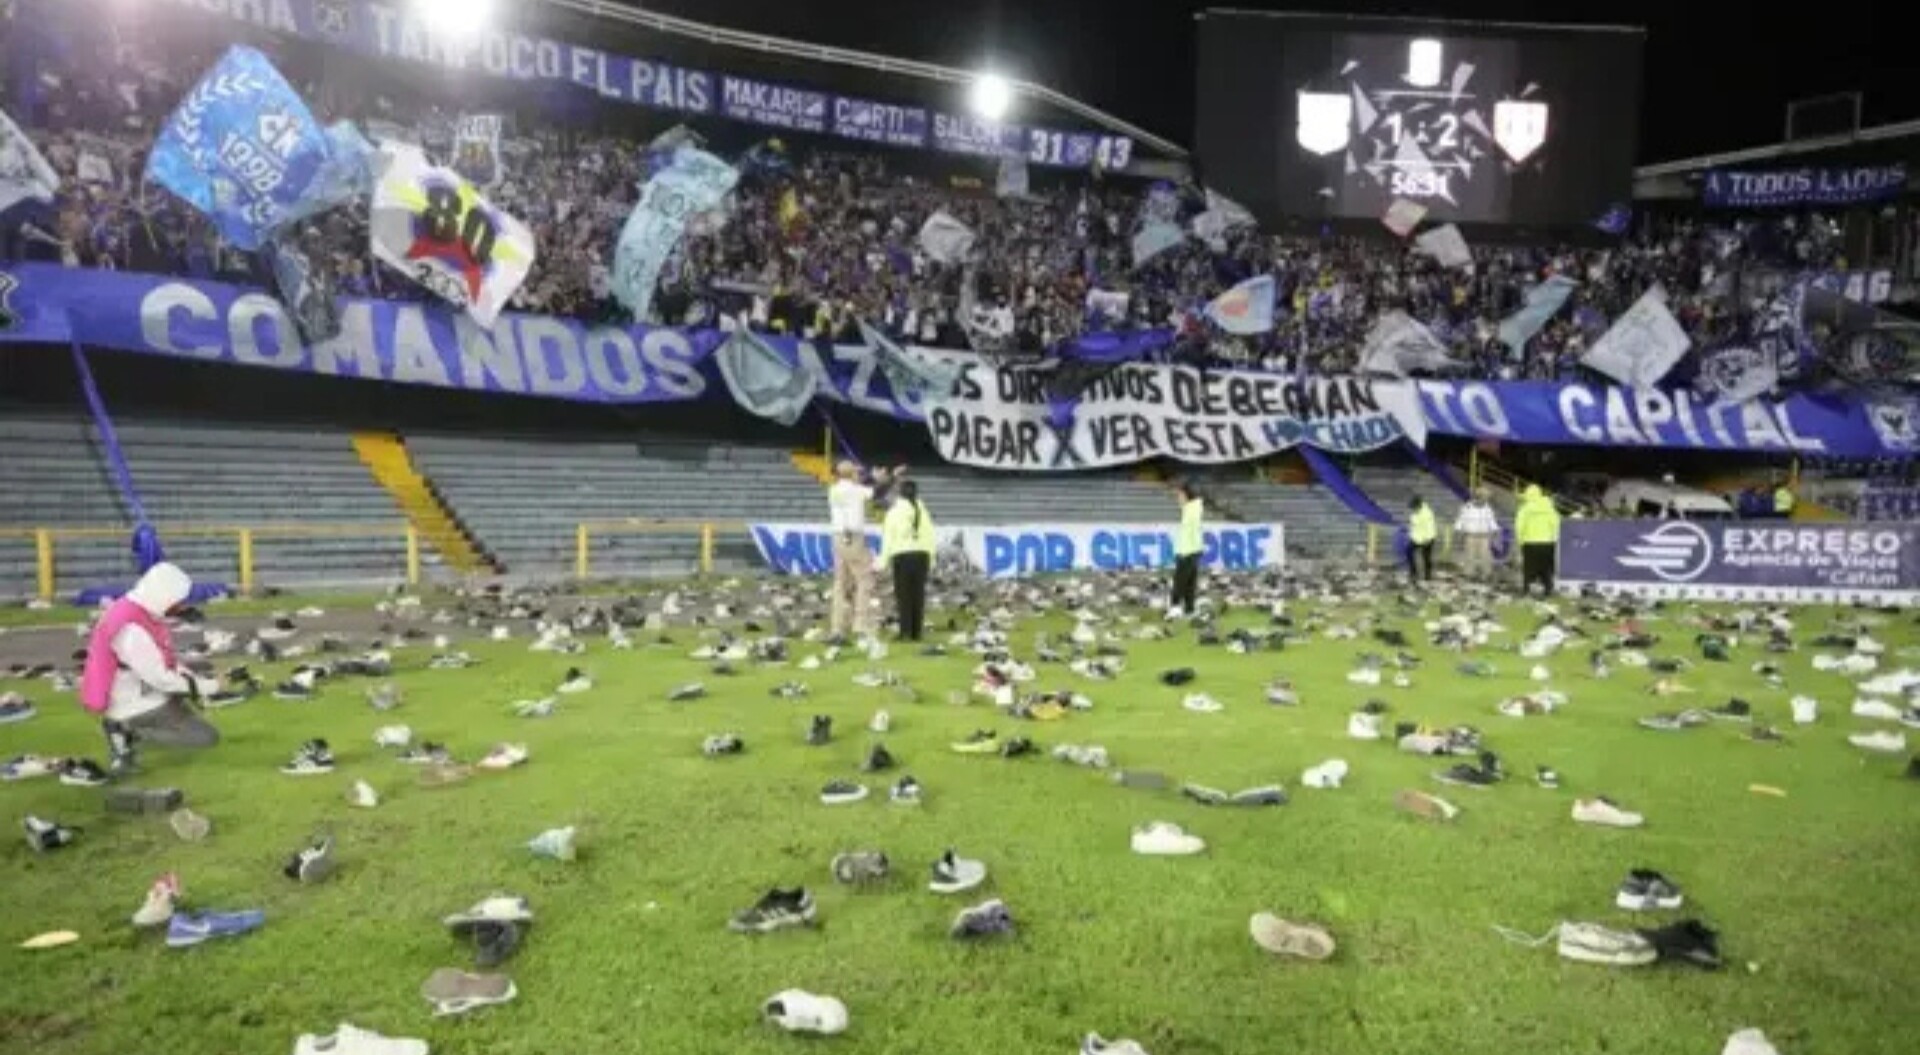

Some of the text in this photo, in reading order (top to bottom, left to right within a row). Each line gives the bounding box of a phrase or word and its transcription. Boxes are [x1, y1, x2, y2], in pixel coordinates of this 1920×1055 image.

[570, 45, 622, 98] EL
[632, 58, 708, 112] PAIS
[1030, 129, 1065, 163] 31
[1439, 112, 1458, 147] 2
[140, 283, 706, 402] COMANDOS
[931, 408, 1041, 465] PAGAR
[1089, 413, 1158, 457] VER
[1163, 416, 1256, 459] ESTA
[1723, 528, 1901, 555] EXPRESO
[1723, 550, 1802, 567] Agencia
[1808, 551, 1834, 567] de
